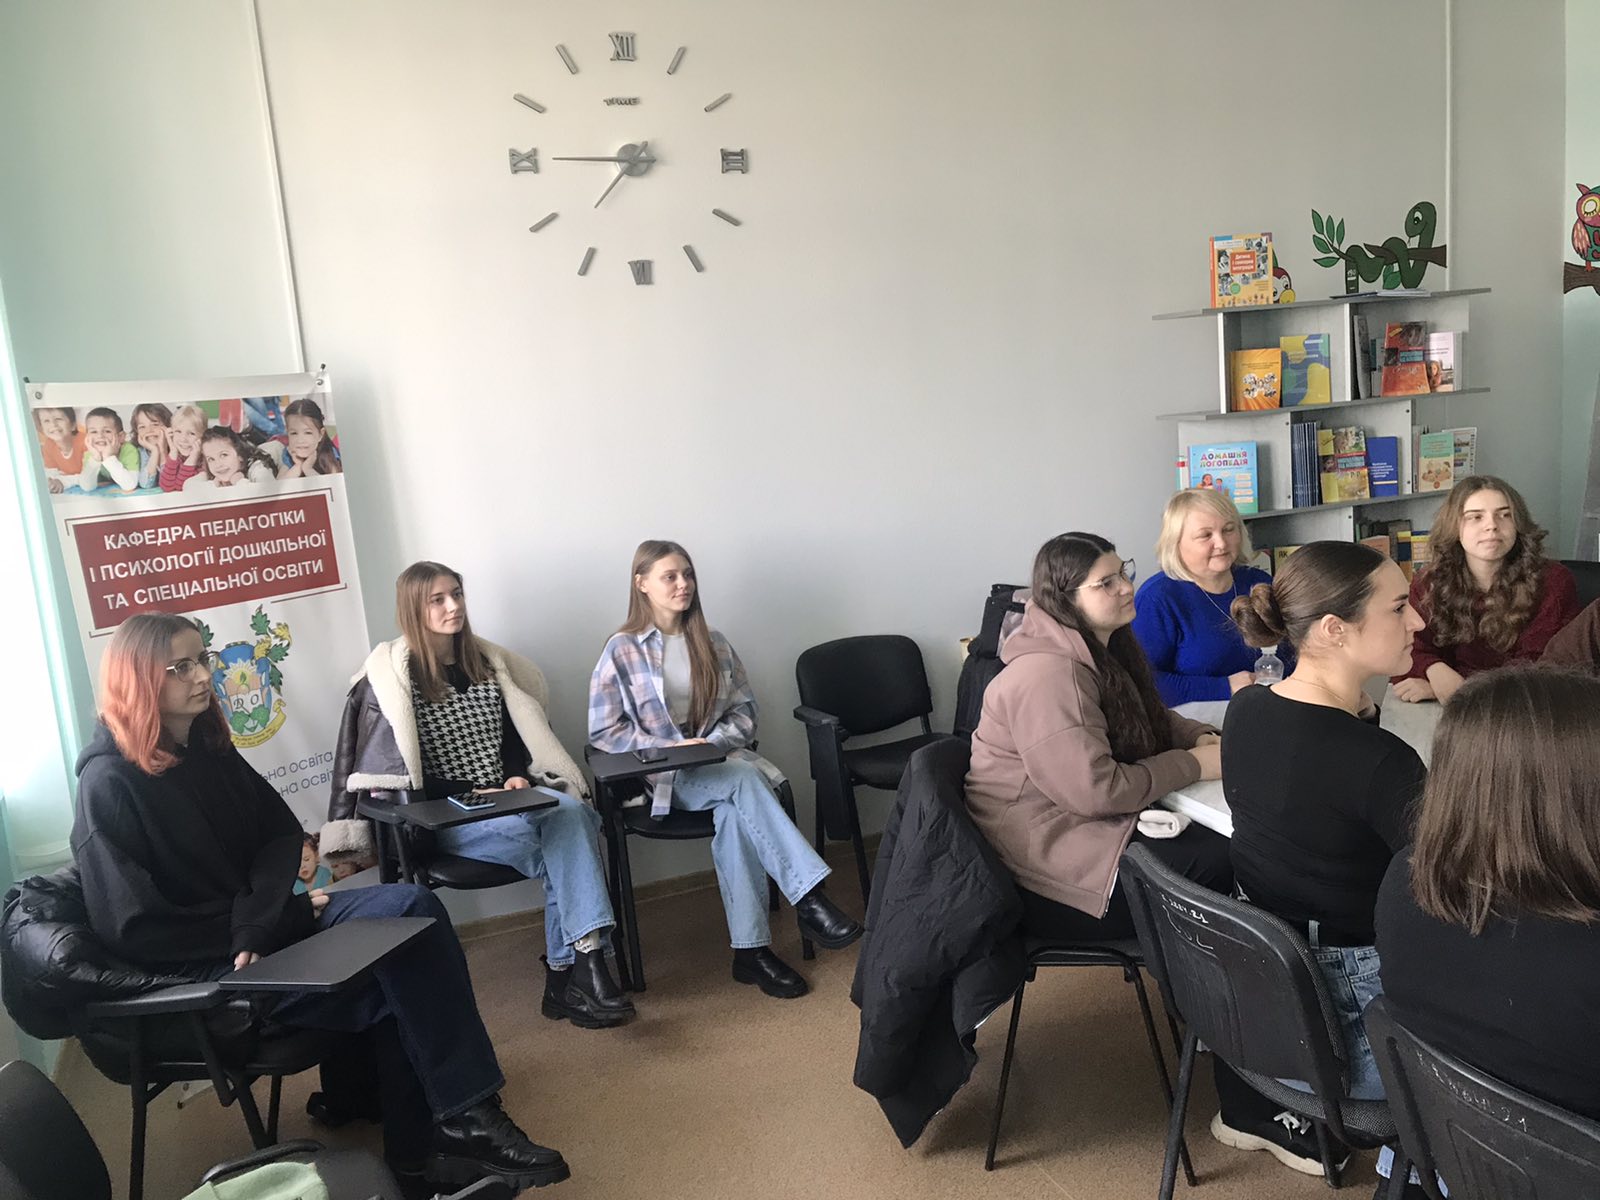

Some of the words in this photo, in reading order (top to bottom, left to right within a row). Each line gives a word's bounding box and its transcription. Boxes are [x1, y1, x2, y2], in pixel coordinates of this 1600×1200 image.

[608, 32, 636, 61] XII
[1200, 459, 1249, 468] ЛОГОПЕДІЯ
[1201, 451, 1248, 461] ДОМАШНЯ
[103, 524, 196, 550] КАФЕДРА
[200, 509, 306, 538] ПЕДАГОГІКИ
[89, 567, 96, 582] І
[100, 549, 215, 582] ПСИХОЛОГІЇ
[219, 530, 327, 565] ДОШКІЛЬНОЇ
[103, 592, 129, 610] ТА
[133, 567, 259, 605] СПЕЦІАЛЬНОЇ
[262, 559, 324, 582] ОСВІТИ
[289, 751, 333, 773] освіта
[301, 769, 333, 789] освіт
